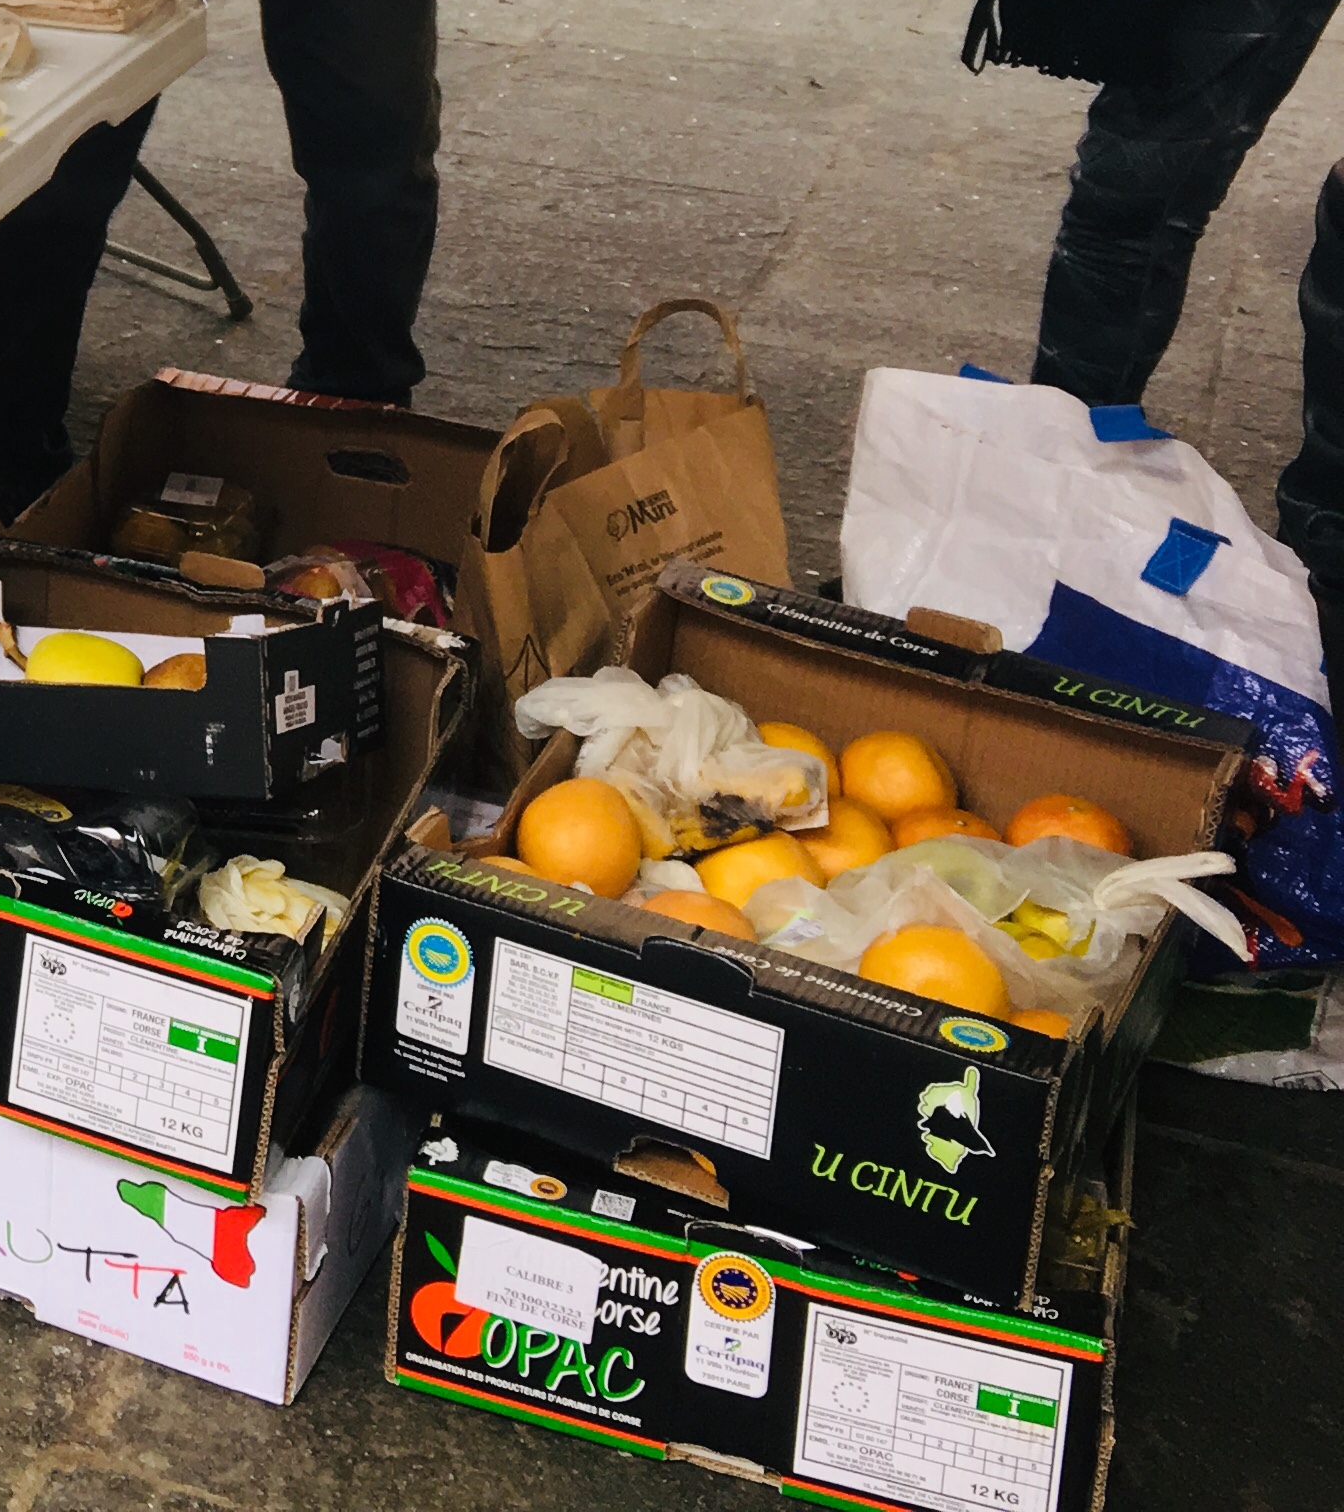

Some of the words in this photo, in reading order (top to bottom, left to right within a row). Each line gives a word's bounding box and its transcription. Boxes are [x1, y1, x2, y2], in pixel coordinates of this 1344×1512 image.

[766, 601, 863, 640] Clémentine
[864, 629, 886, 644] de
[889, 635, 940, 658] Corse
[1089, 688, 1207, 729] CINTU
[426, 857, 548, 904] CINTU
[73, 888, 116, 910] OPAC
[176, 919, 220, 940] Corse
[224, 934, 245, 948] de
[164, 928, 247, 962] Clémentine
[635, 997, 672, 1015] FRANCE
[803, 972, 924, 1019] Clémentine
[131, 1008, 167, 1027] FRANCE
[403, 999, 463, 1029] Certipaq
[132, 1022, 163, 1038] CORSE
[648, 1032, 661, 1044] 12
[661, 1037, 685, 1053] KGS
[64, 1076, 96, 1093] OPAC
[620, 1076, 627, 1085] 2
[661, 1089, 668, 1099] 3
[701, 1104, 709, 1113] 4
[159, 1116, 177, 1131] 12
[180, 1121, 205, 1139] KG
[850, 1160, 979, 1226] CINTU
[506, 1264, 564, 1291] CALIBRE
[566, 1284, 575, 1295] 3
[486, 1290, 517, 1310] FINE
[519, 1301, 539, 1316] DE
[541, 1308, 588, 1332] CORSE
[741, 1329, 760, 1340] PAR
[480, 1312, 646, 1403] OPAC
[695, 1343, 765, 1373] Certipaq
[405, 1351, 467, 1377] ORGANISATION
[467, 1367, 485, 1384] DES
[485, 1372, 547, 1400] PRODUCTEURS
[547, 1390, 598, 1413] D'AGRUMES
[598, 1404, 611, 1418] DE
[612, 1407, 642, 1428] CORSE
[933, 1375, 975, 1393] FRANCE
[936, 1388, 970, 1404] CORSE
[859, 1446, 894, 1462] OPAC
[937, 1440, 944, 1449] 2
[970, 1483, 990, 1498] 12
[993, 1488, 1021, 1506] KG
